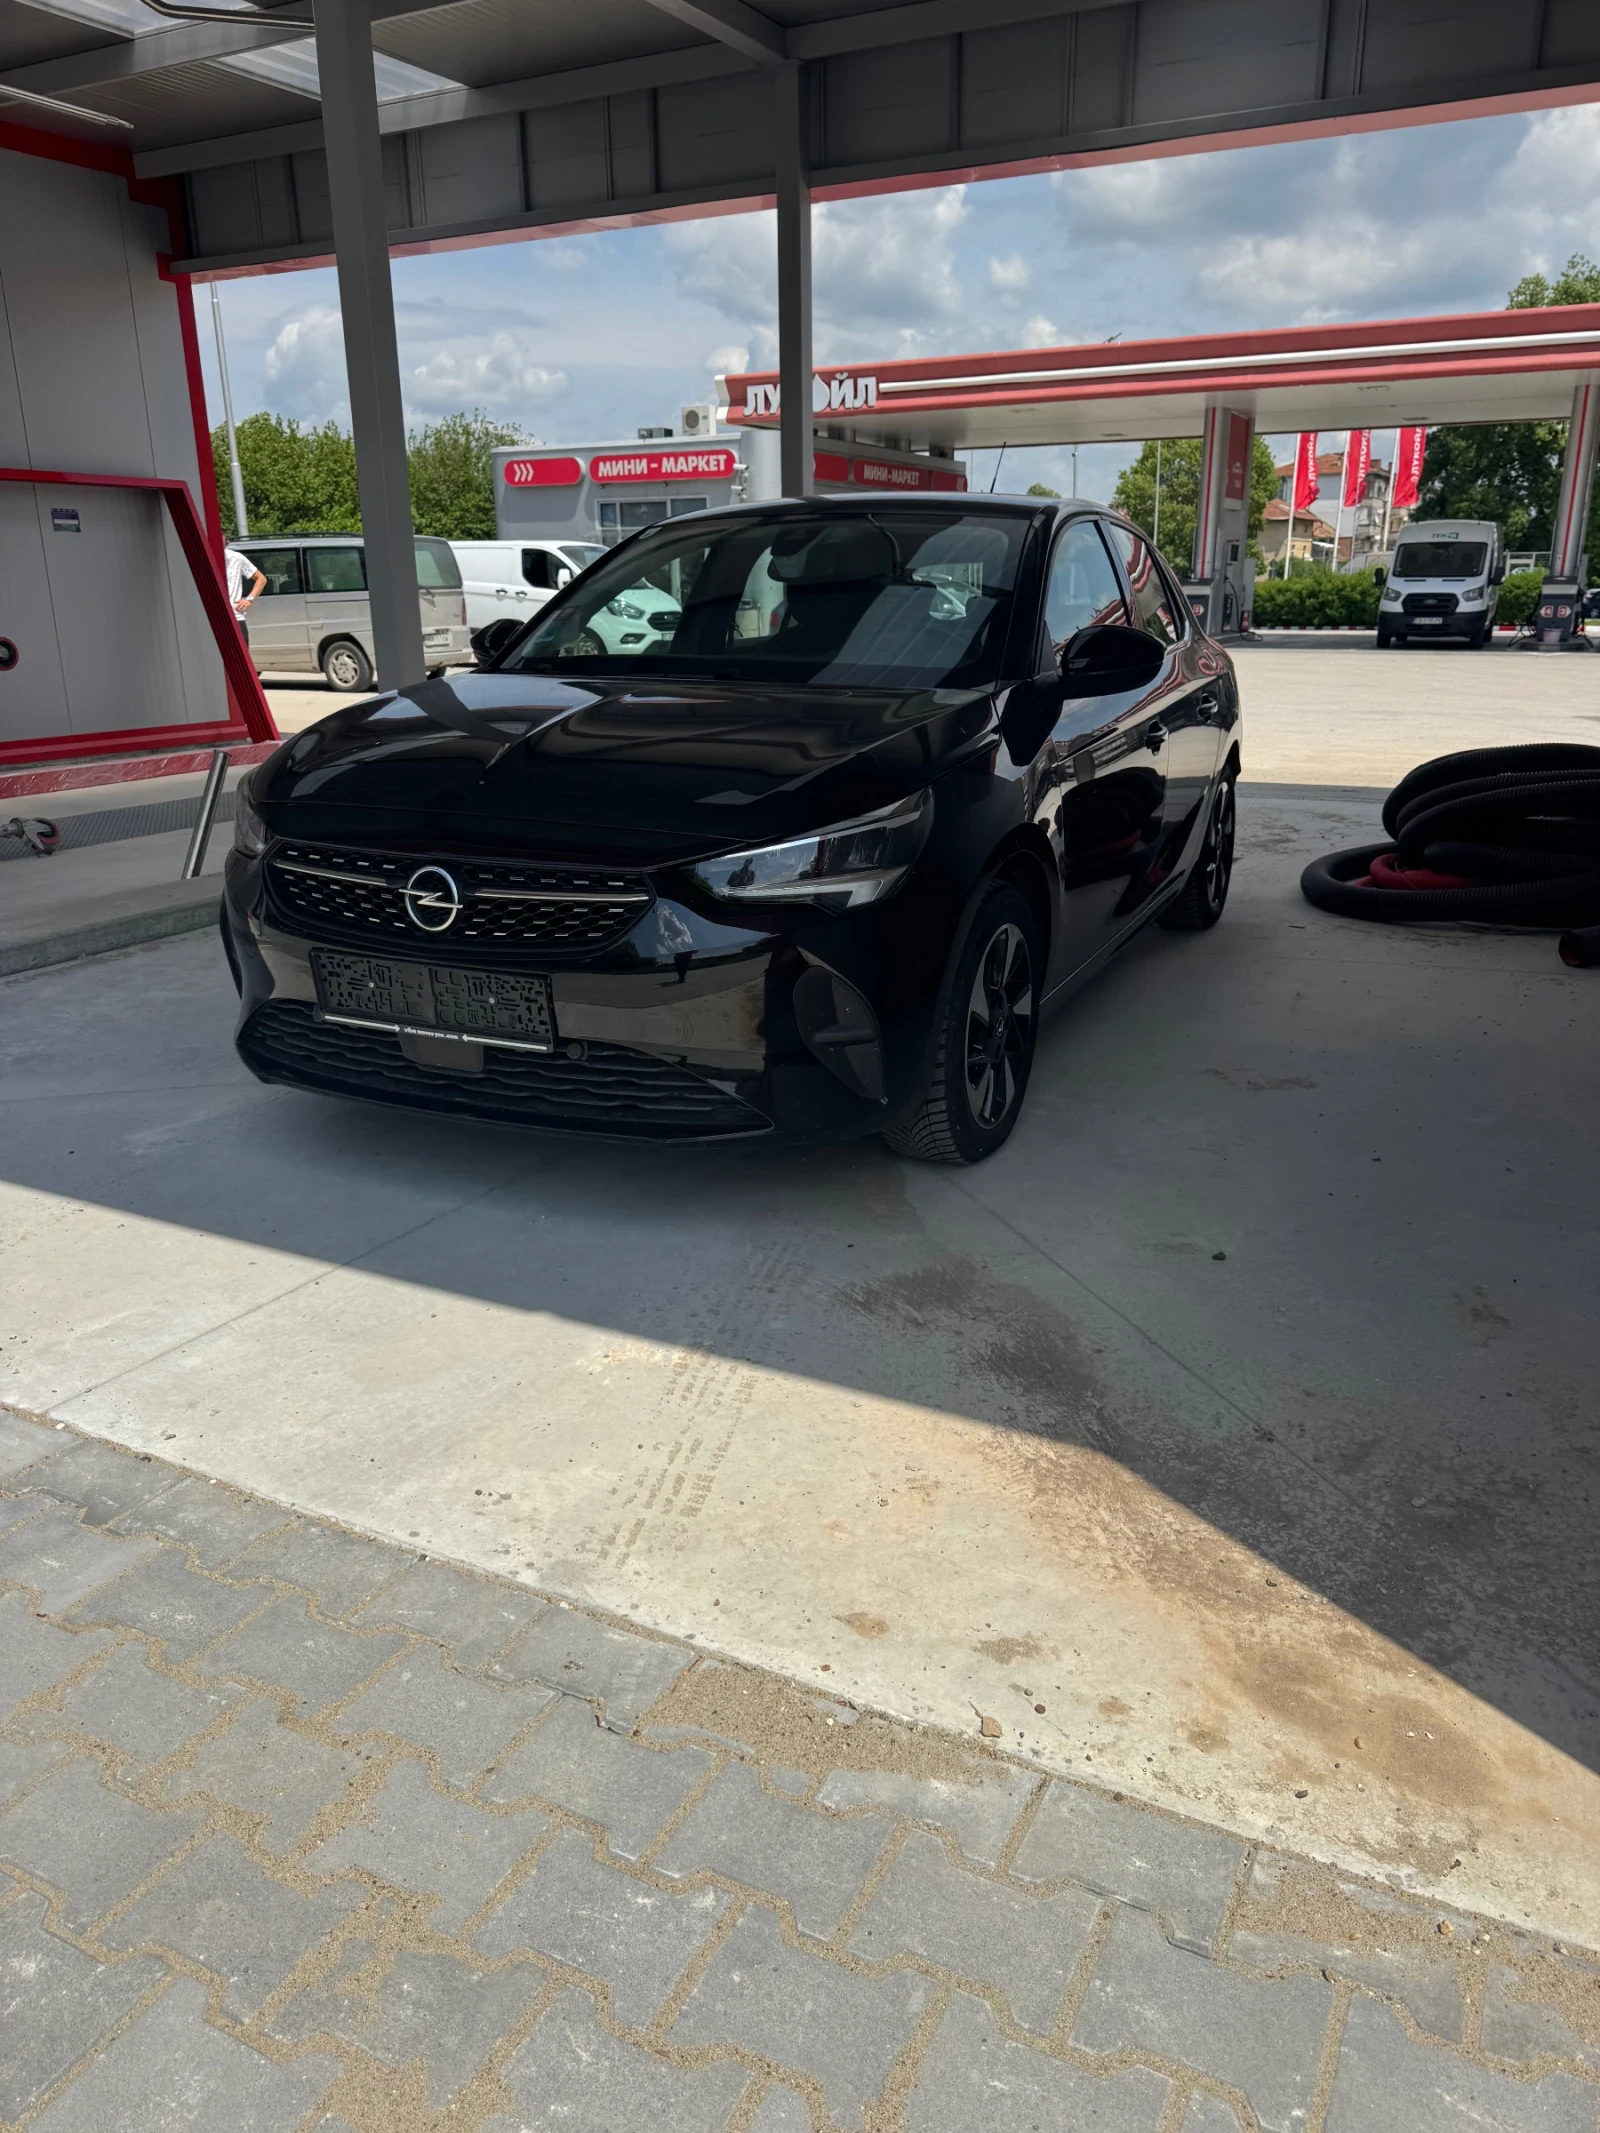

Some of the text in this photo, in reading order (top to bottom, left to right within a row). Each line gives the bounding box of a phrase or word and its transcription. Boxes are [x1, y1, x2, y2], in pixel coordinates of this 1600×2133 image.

[743, 371, 877, 416] ЛУОЙЛ
[598, 458, 648, 477] МИНИ
[661, 454, 727, 474] МАРКЕТ
